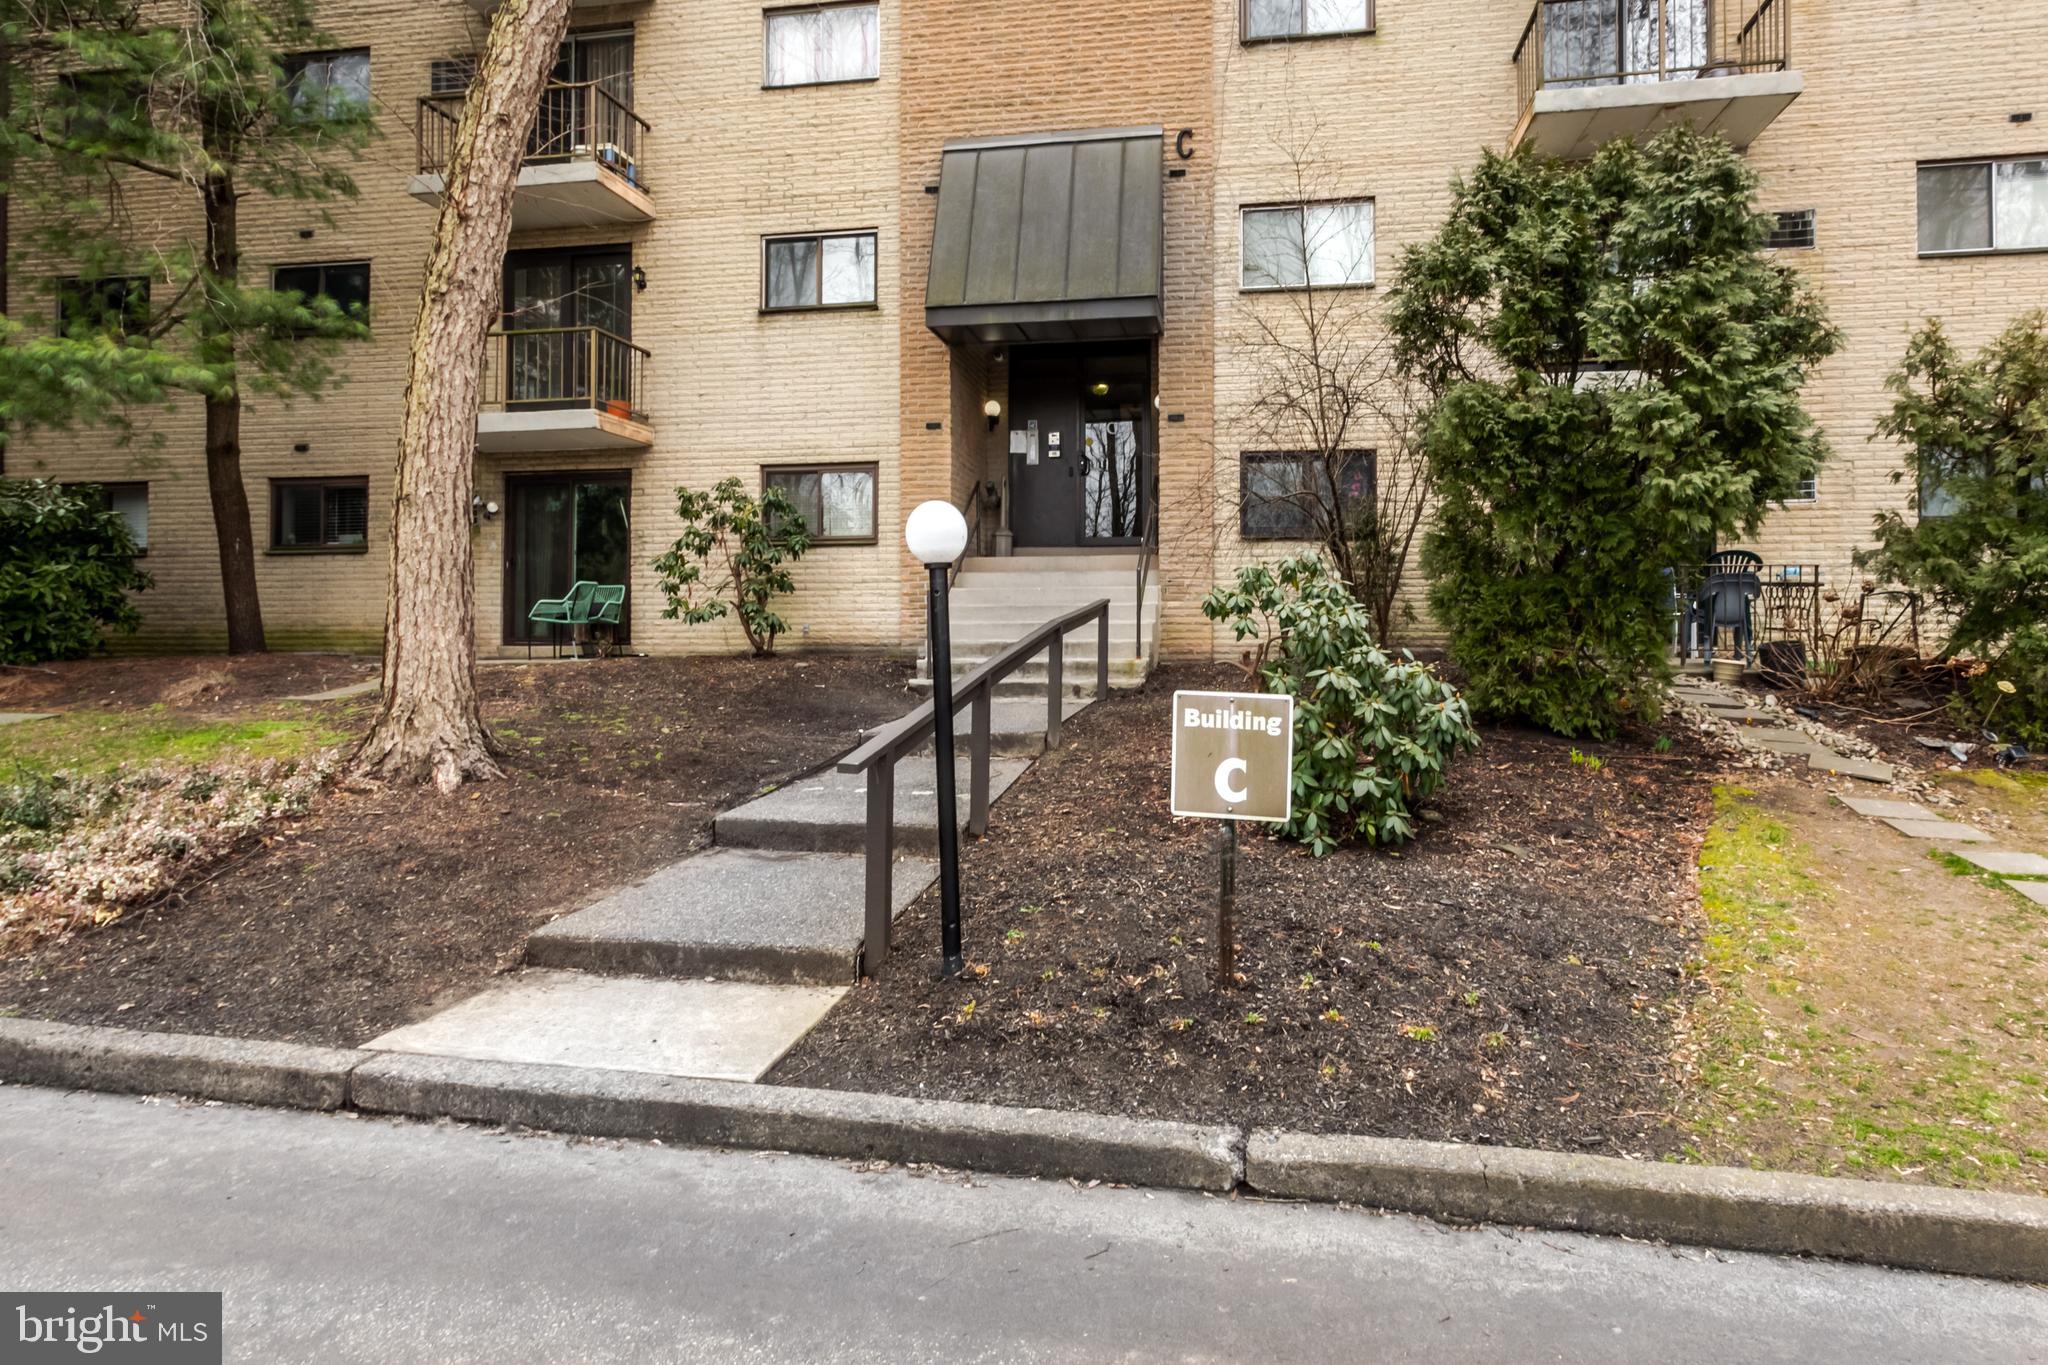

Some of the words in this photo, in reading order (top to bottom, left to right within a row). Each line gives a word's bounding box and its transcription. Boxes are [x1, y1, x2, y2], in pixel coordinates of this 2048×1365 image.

[1176, 127, 1193, 160] C
[1183, 707, 1283, 737] Building
[1214, 757, 1248, 803] C
